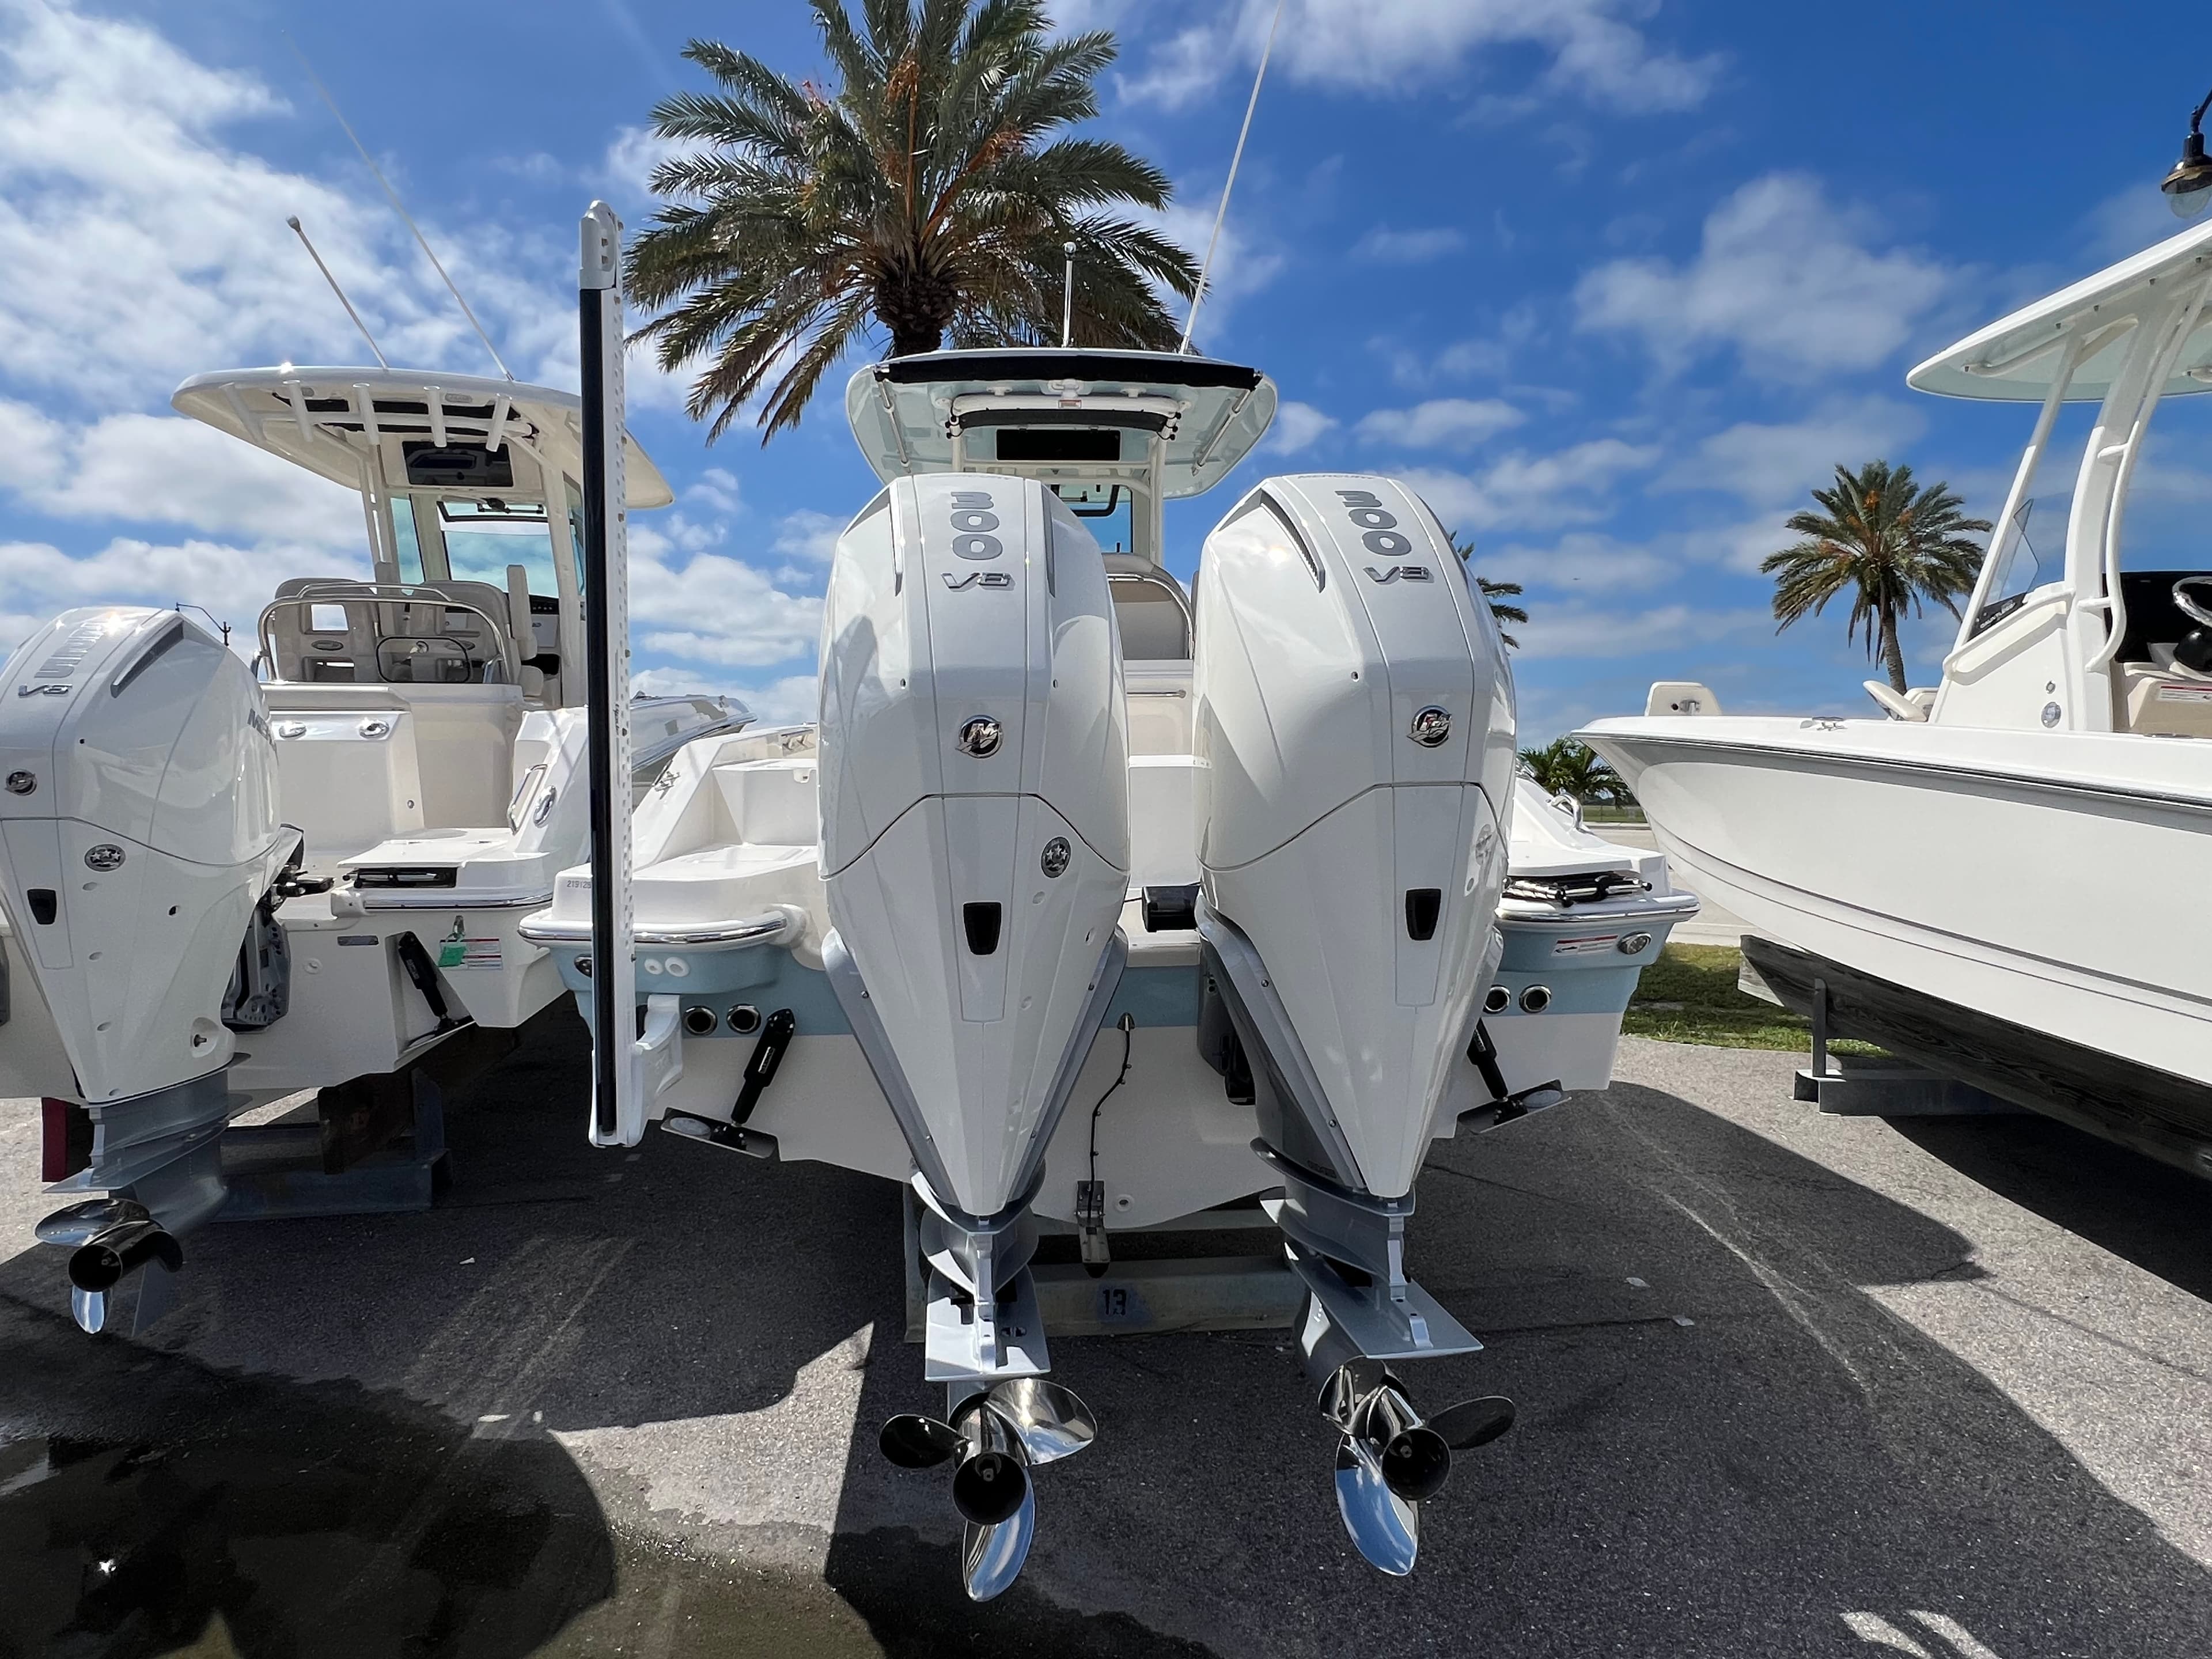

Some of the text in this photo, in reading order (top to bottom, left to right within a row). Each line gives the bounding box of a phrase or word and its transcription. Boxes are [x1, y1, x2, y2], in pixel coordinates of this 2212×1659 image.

[950, 491, 1003, 560] 300
[1335, 490, 1412, 556] 300
[941, 572, 1011, 589] V8
[1363, 566, 1430, 582] V8
[1103, 1289, 1127, 1316] 13
